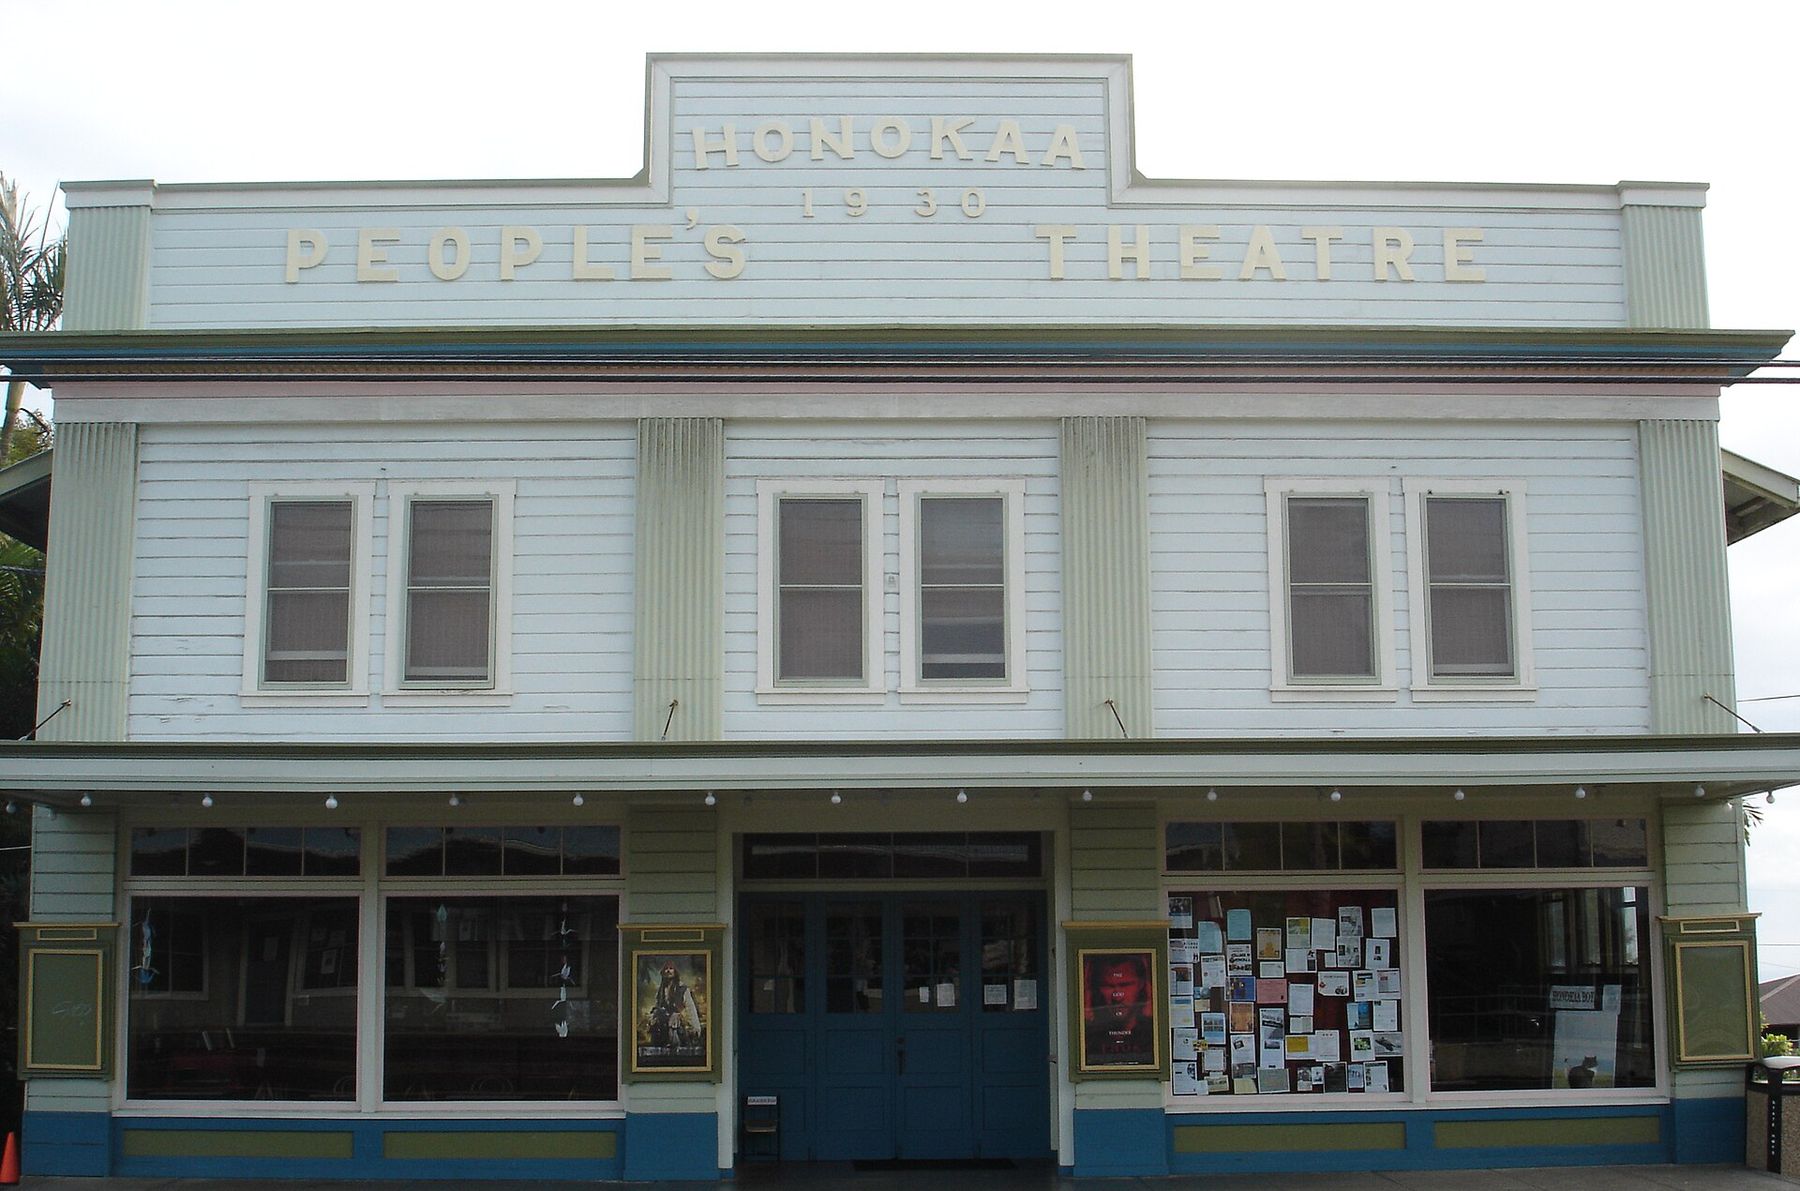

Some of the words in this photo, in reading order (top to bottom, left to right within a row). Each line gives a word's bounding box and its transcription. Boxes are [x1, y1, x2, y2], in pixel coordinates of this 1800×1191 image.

[692, 115, 1085, 170] HONOKAA
[801, 187, 986, 218] 1930
[284, 209, 747, 283] PEOPLE'S
[1035, 224, 1487, 283] THEATRE
